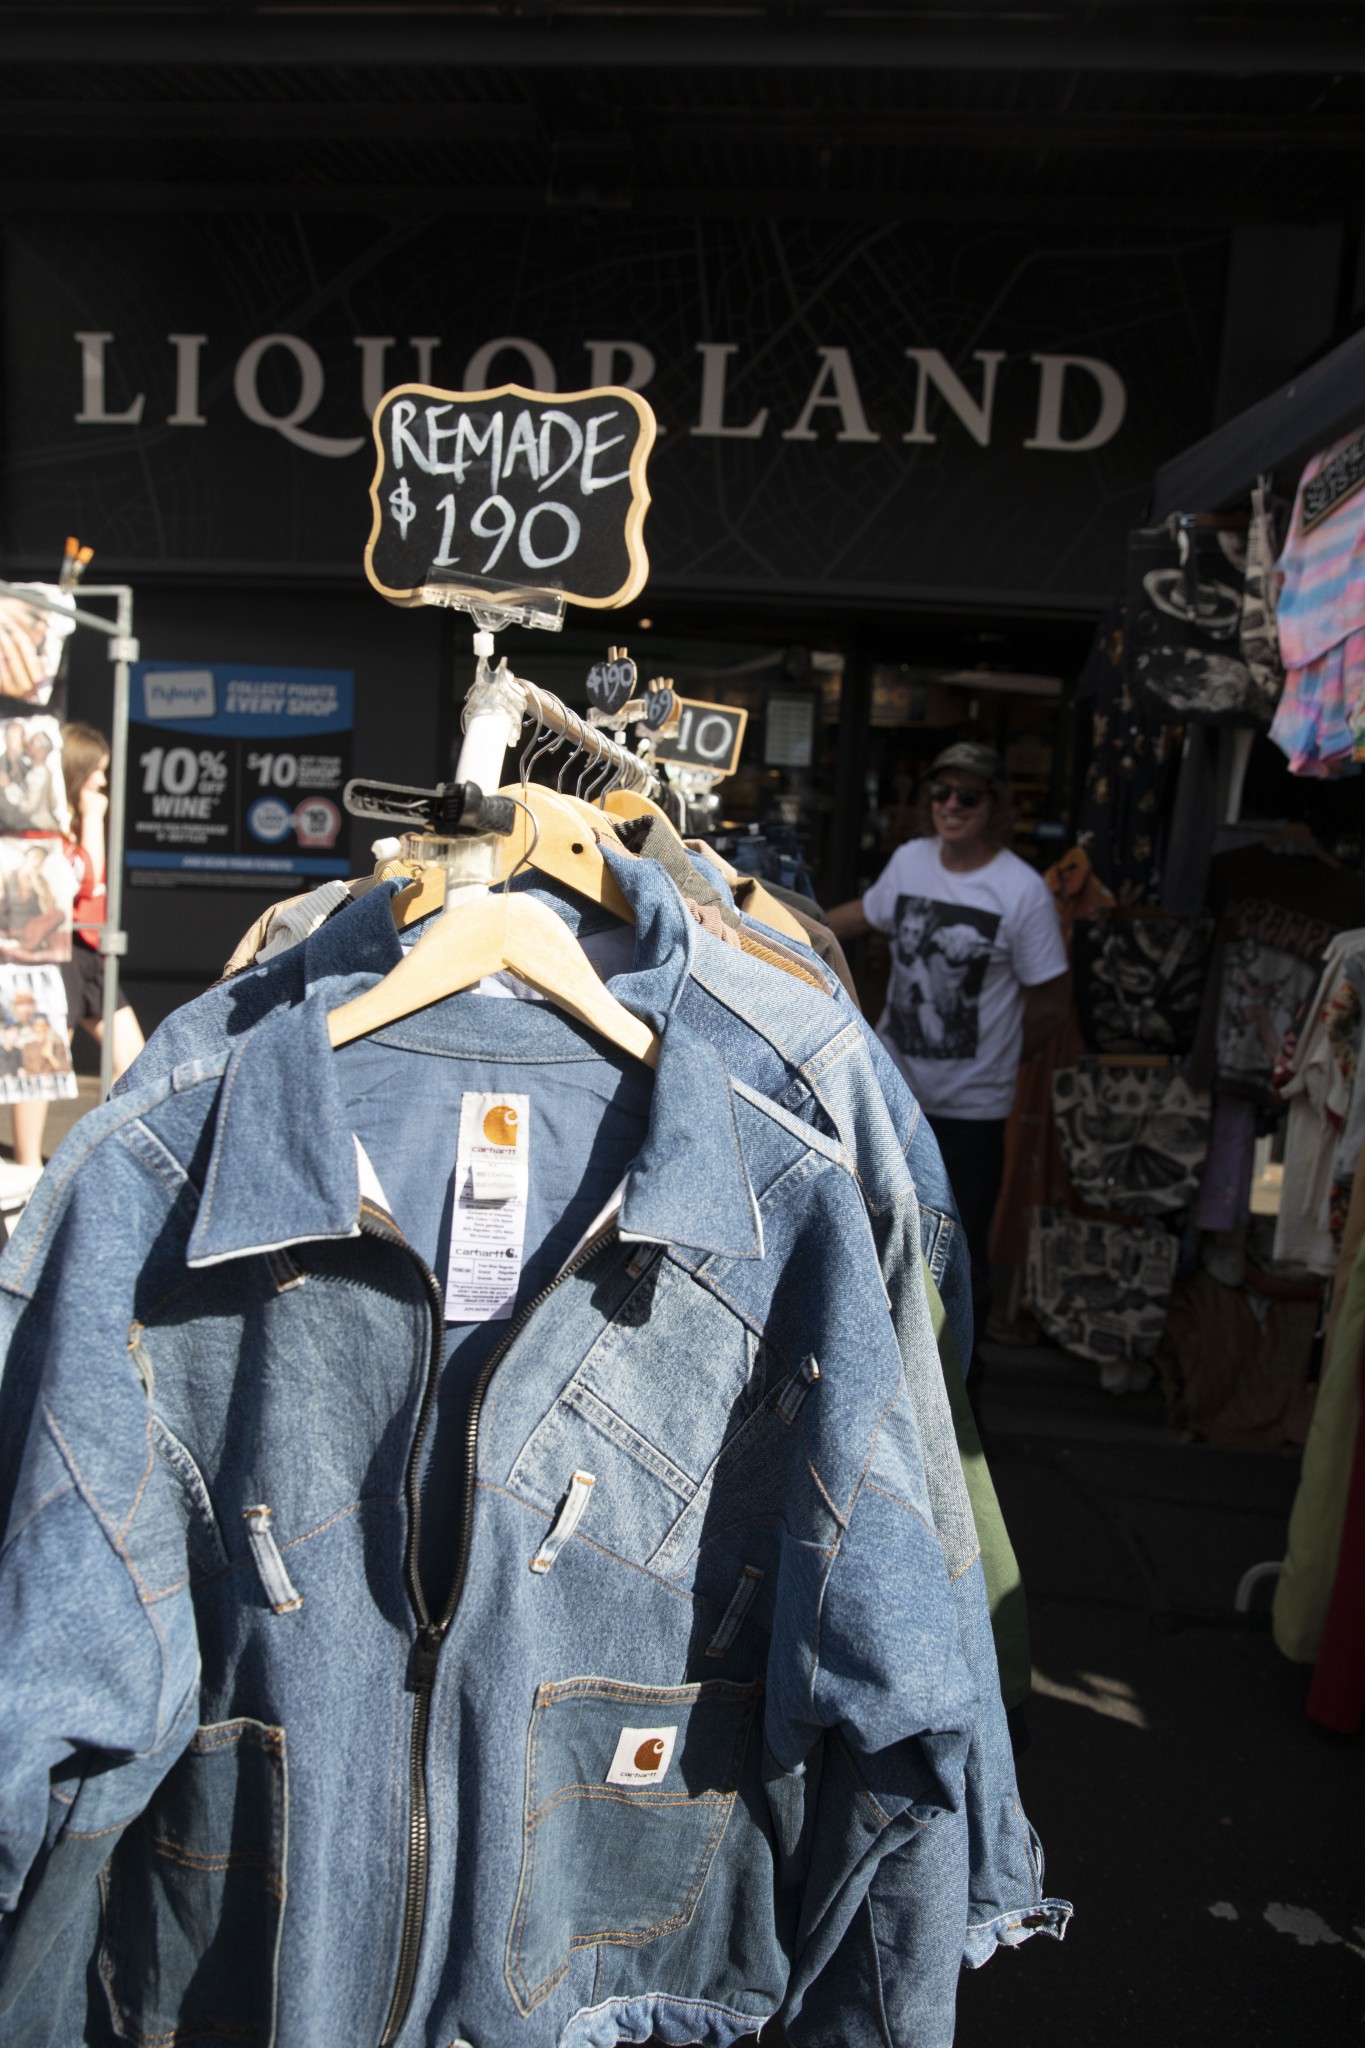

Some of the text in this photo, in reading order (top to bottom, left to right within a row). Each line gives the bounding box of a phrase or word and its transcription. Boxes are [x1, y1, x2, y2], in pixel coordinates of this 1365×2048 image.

[391, 399, 632, 496] REMADE
[227, 680, 338, 698] COLLECT POINTS
[587, 661, 634, 702] $190
[225, 698, 339, 717] EVERY SHOP
[139, 746, 228, 795] 10%
[246, 752, 297, 788] $10
[198, 781, 227, 795] OFF
[471, 1146, 516, 1155] carhartt
[455, 1248, 504, 1258] carhartt
[620, 1771, 657, 1779] carhartt
